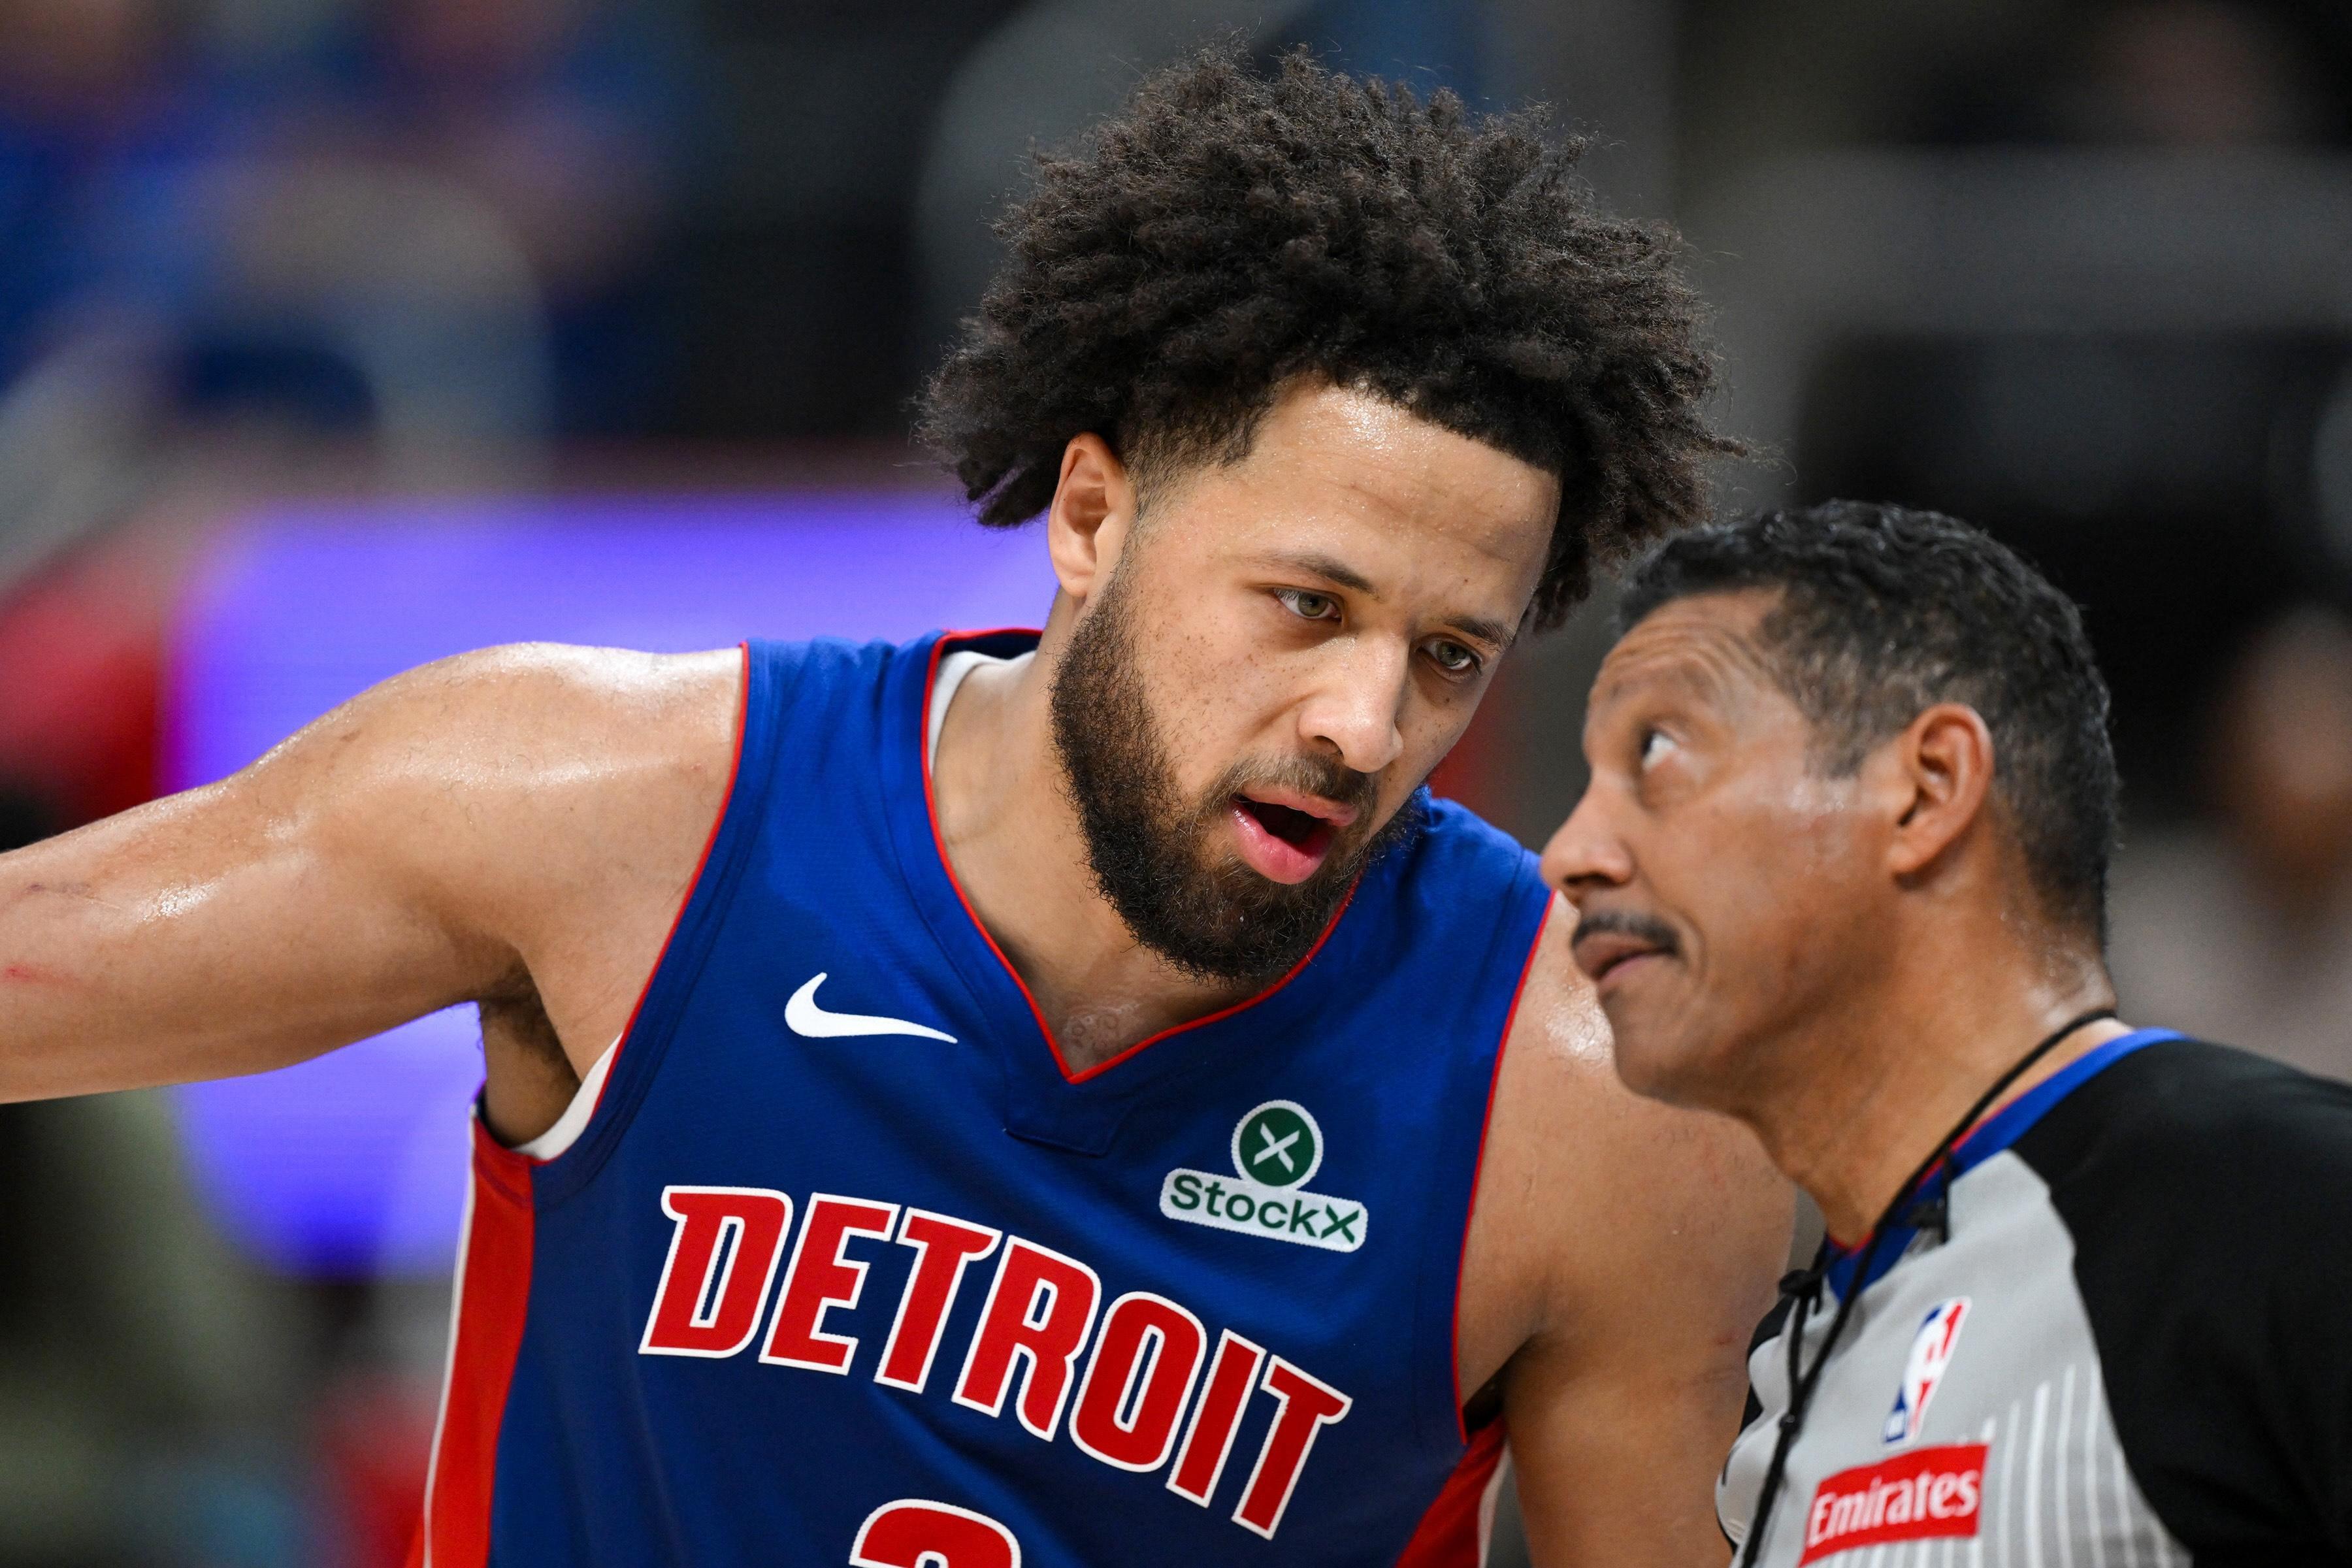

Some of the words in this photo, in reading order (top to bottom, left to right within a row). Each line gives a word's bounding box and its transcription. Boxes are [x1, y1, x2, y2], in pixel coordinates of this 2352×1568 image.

[1170, 1174, 1360, 1244] StockX
[638, 1186, 1353, 1541] DETROIT
[1807, 1469, 1980, 1548] Emirates
